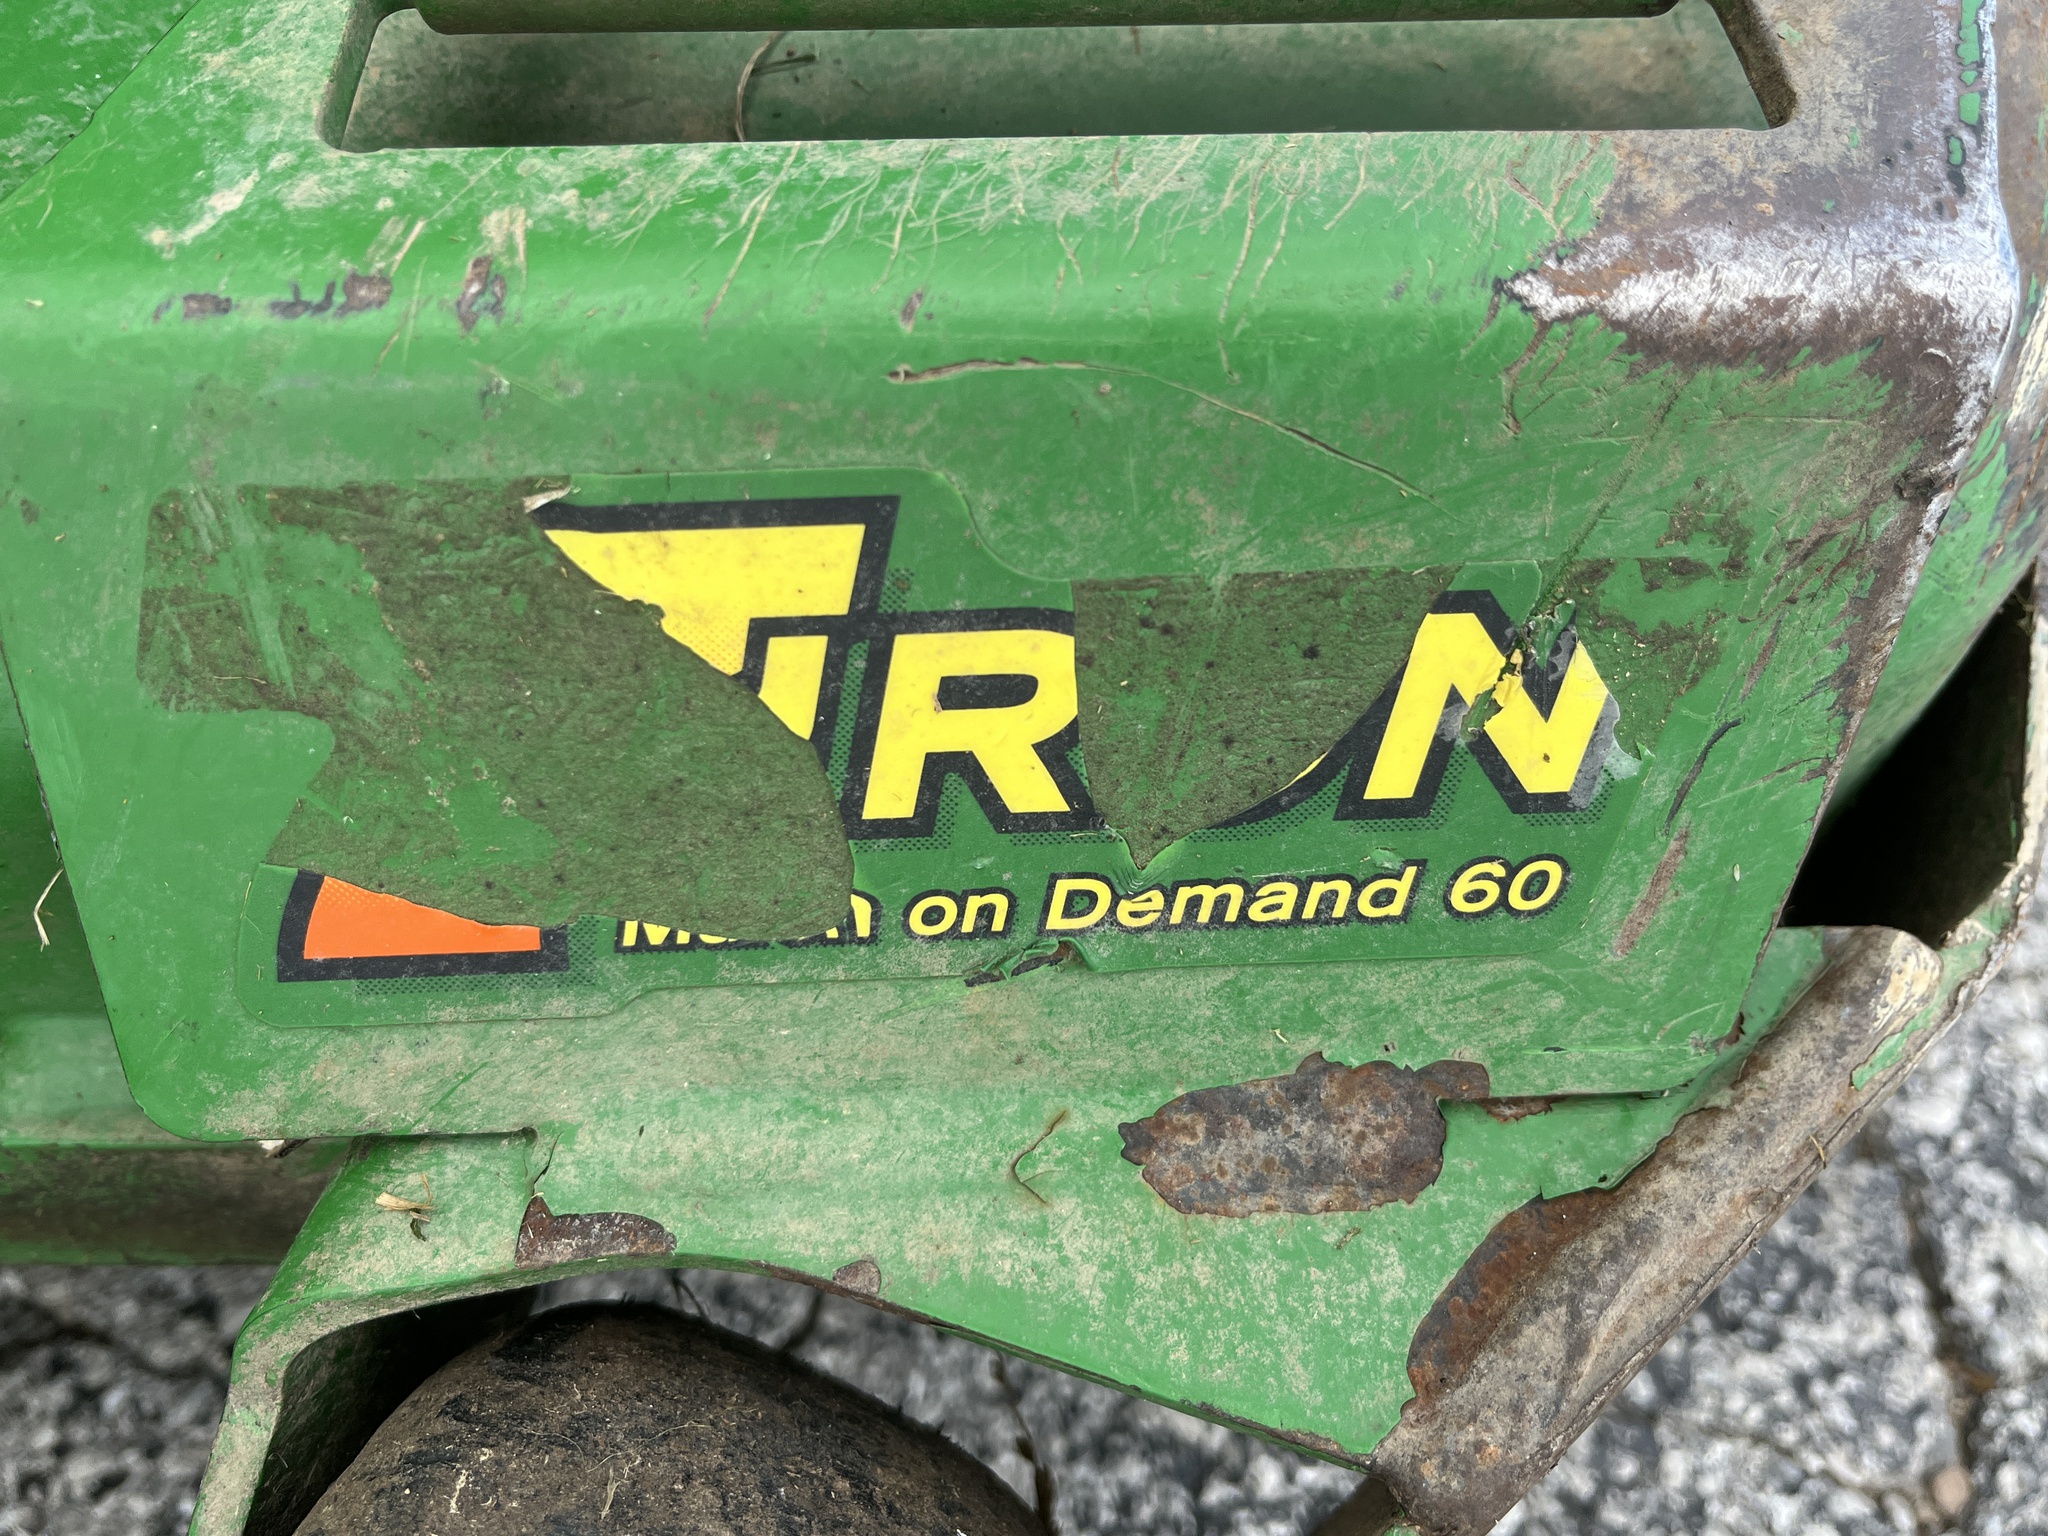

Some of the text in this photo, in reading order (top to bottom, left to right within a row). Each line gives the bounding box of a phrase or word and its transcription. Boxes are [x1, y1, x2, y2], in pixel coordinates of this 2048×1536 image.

[907, 891, 1010, 937] on
[1043, 864, 1420, 932] Demand
[1447, 857, 1566, 915] 60
